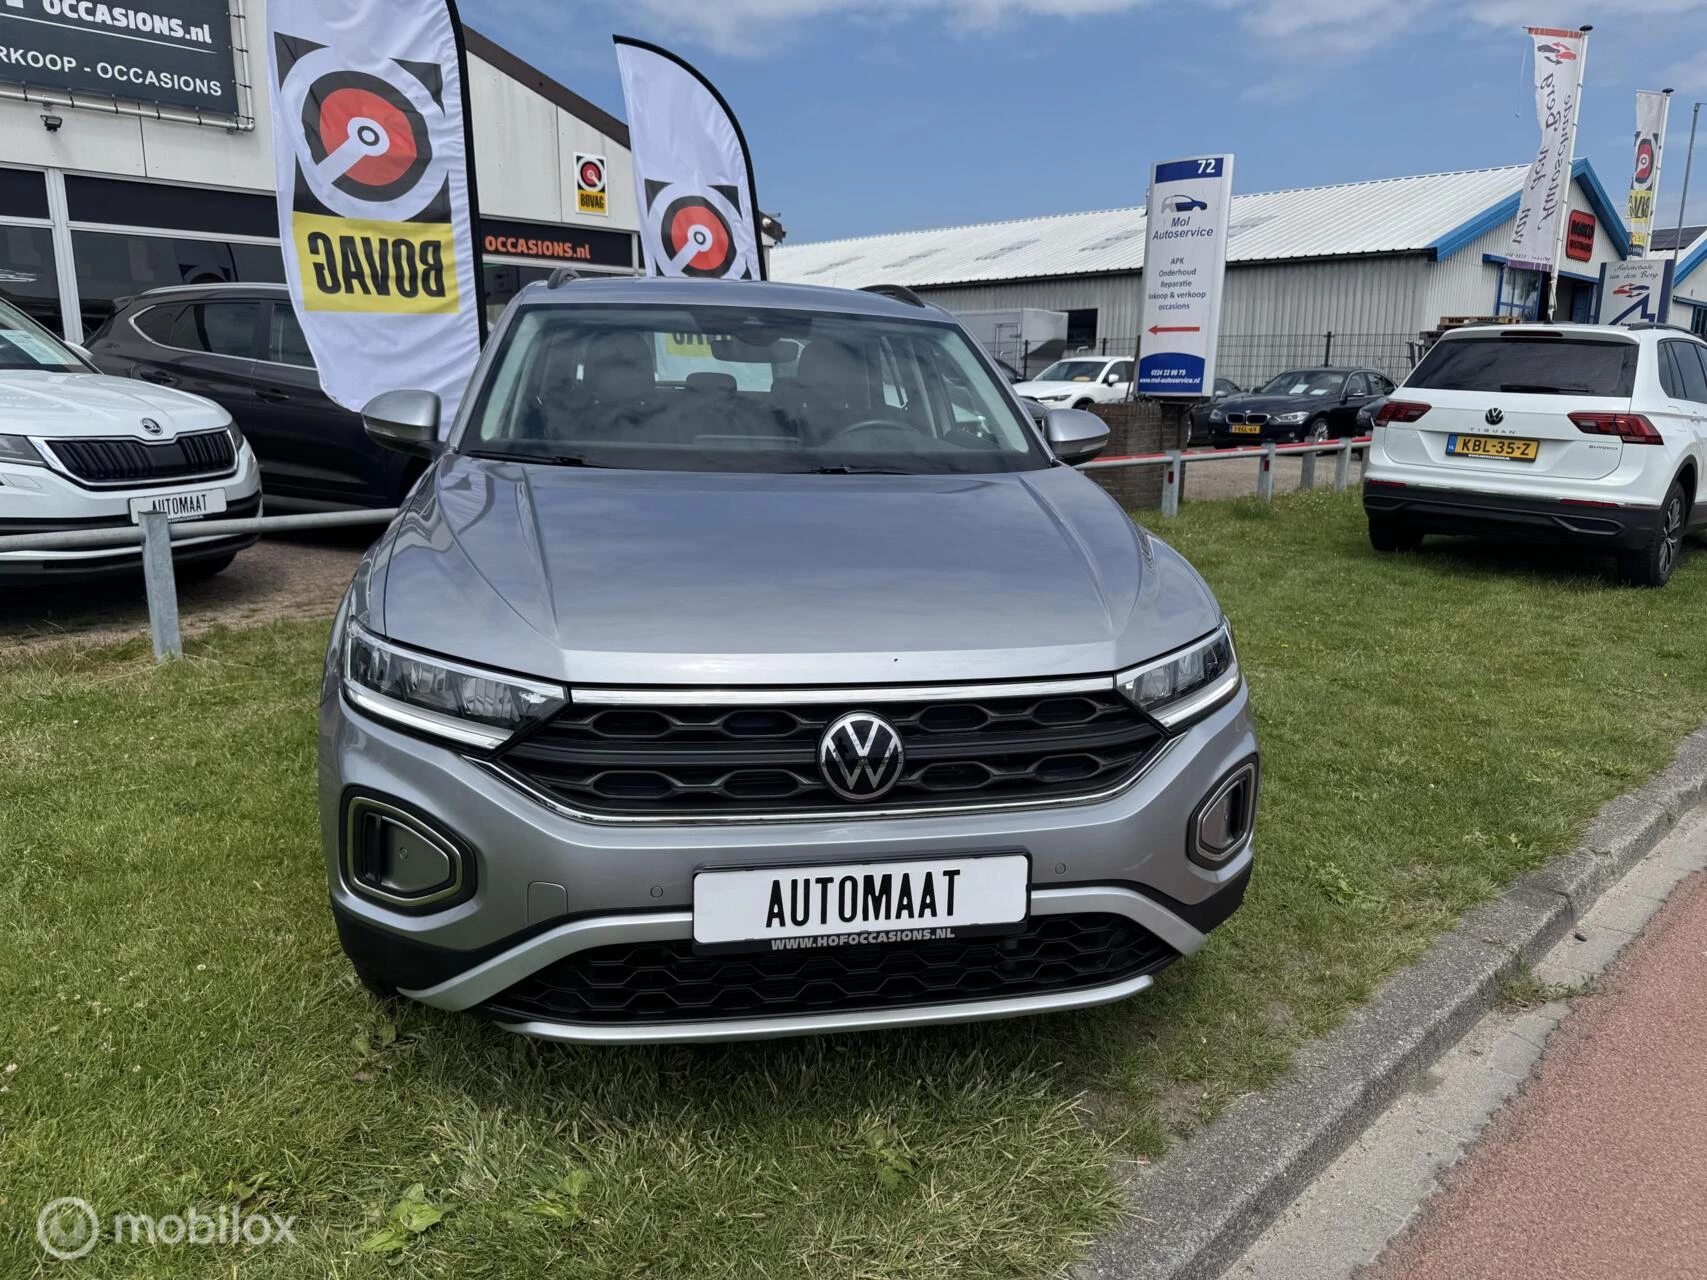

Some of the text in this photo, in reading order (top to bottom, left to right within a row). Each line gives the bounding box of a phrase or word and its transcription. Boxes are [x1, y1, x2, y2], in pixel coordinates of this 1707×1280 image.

[42, 0, 212, 44] OCCASIONS.nl
[96, 62, 222, 96] OCCASIONS
[1197, 158, 1215, 174] 72
[580, 194, 604, 209] BOVAG
[1171, 216, 1191, 227] Mol
[1152, 227, 1213, 240] Autoservice
[485, 235, 591, 259] OCCASIONS.nl
[1170, 257, 1184, 265] APK
[1159, 268, 1197, 277] Onderhoud
[1160, 280, 1192, 289] Reparatie
[1176, 291, 1206, 299] verkoop
[1158, 303, 1190, 311] occasions
[1461, 438, 1531, 456] KBL-35-Z
[152, 494, 206, 515] AUTOMAAT
[765, 869, 961, 928] AUTOMAAT
[771, 928, 955, 950] WWW.HOFOCCASIONS.NL
